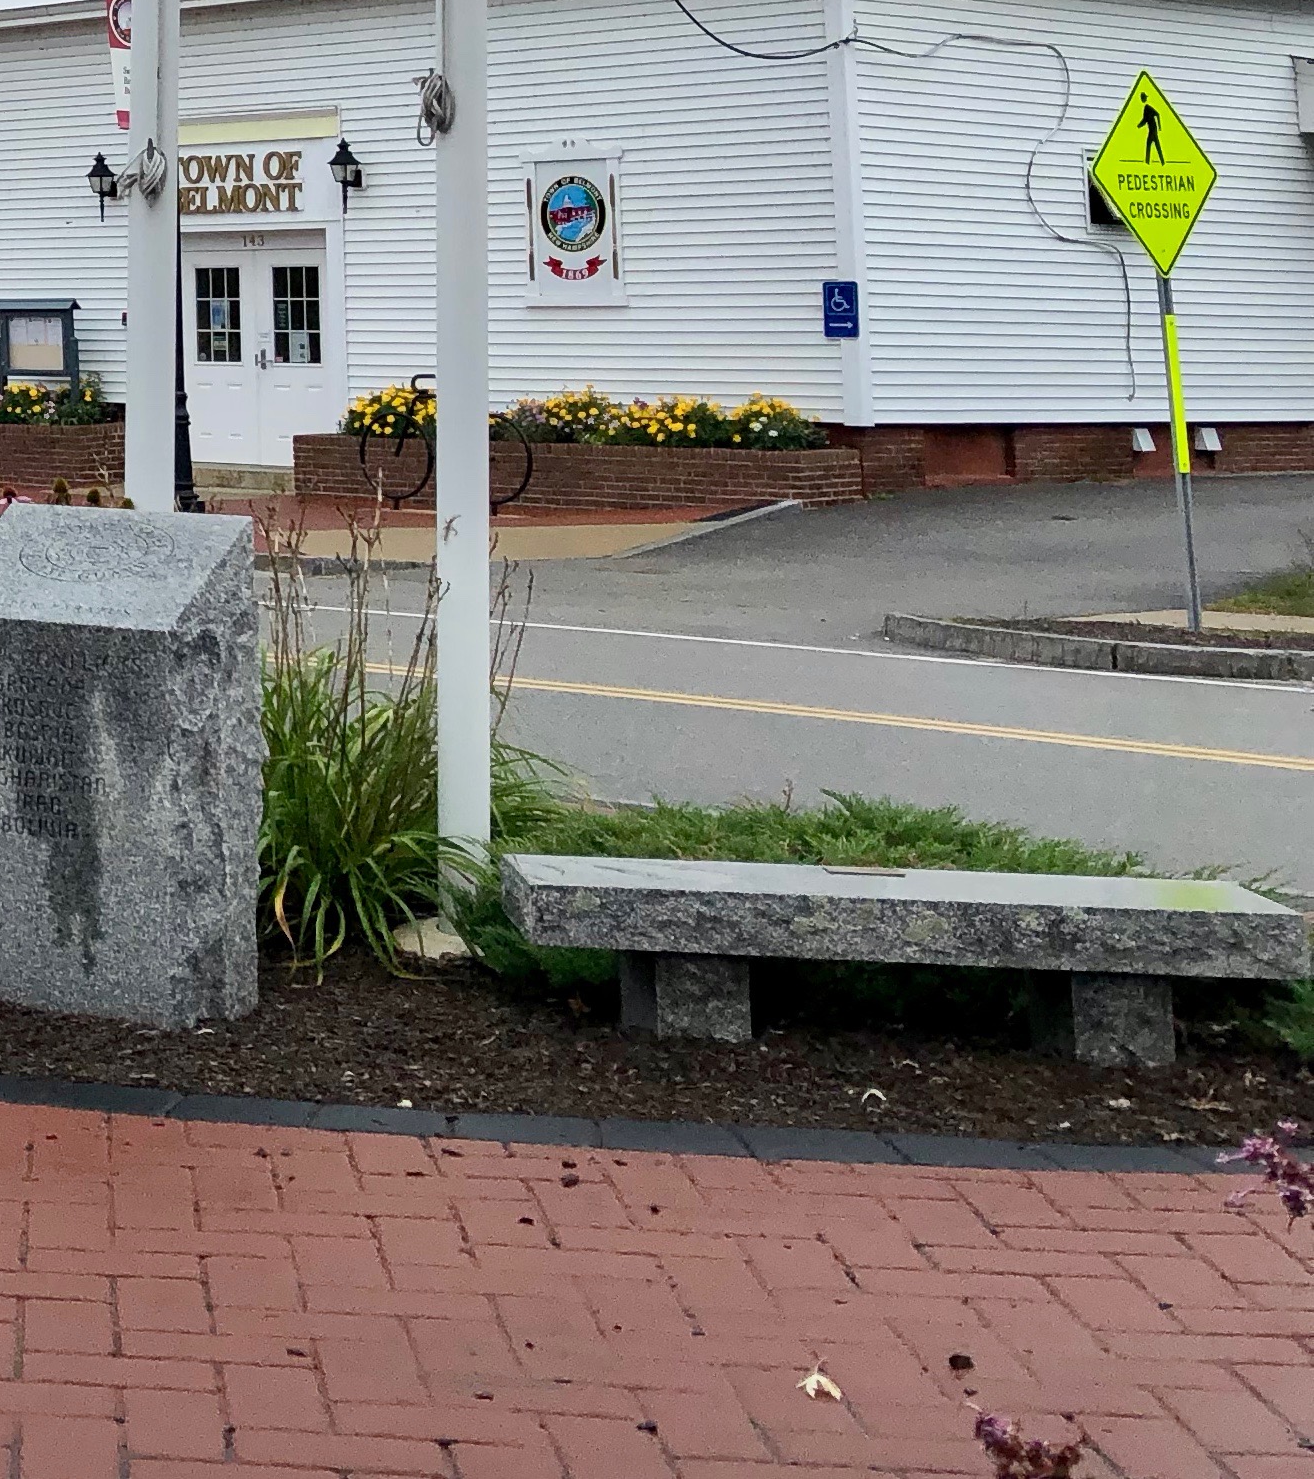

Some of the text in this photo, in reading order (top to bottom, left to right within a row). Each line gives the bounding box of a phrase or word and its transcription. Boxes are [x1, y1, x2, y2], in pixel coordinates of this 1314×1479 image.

[263, 151, 302, 180] OF
[544, 177, 604, 203] TOWN OF BELMONT
[1117, 173, 1196, 192] PEDESTRIAN
[179, 183, 303, 215] ELMONT
[1129, 202, 1191, 220] CROSSING
[241, 234, 265, 248] 143
[546, 231, 562, 247] NEW
[561, 268, 589, 280] 1869
